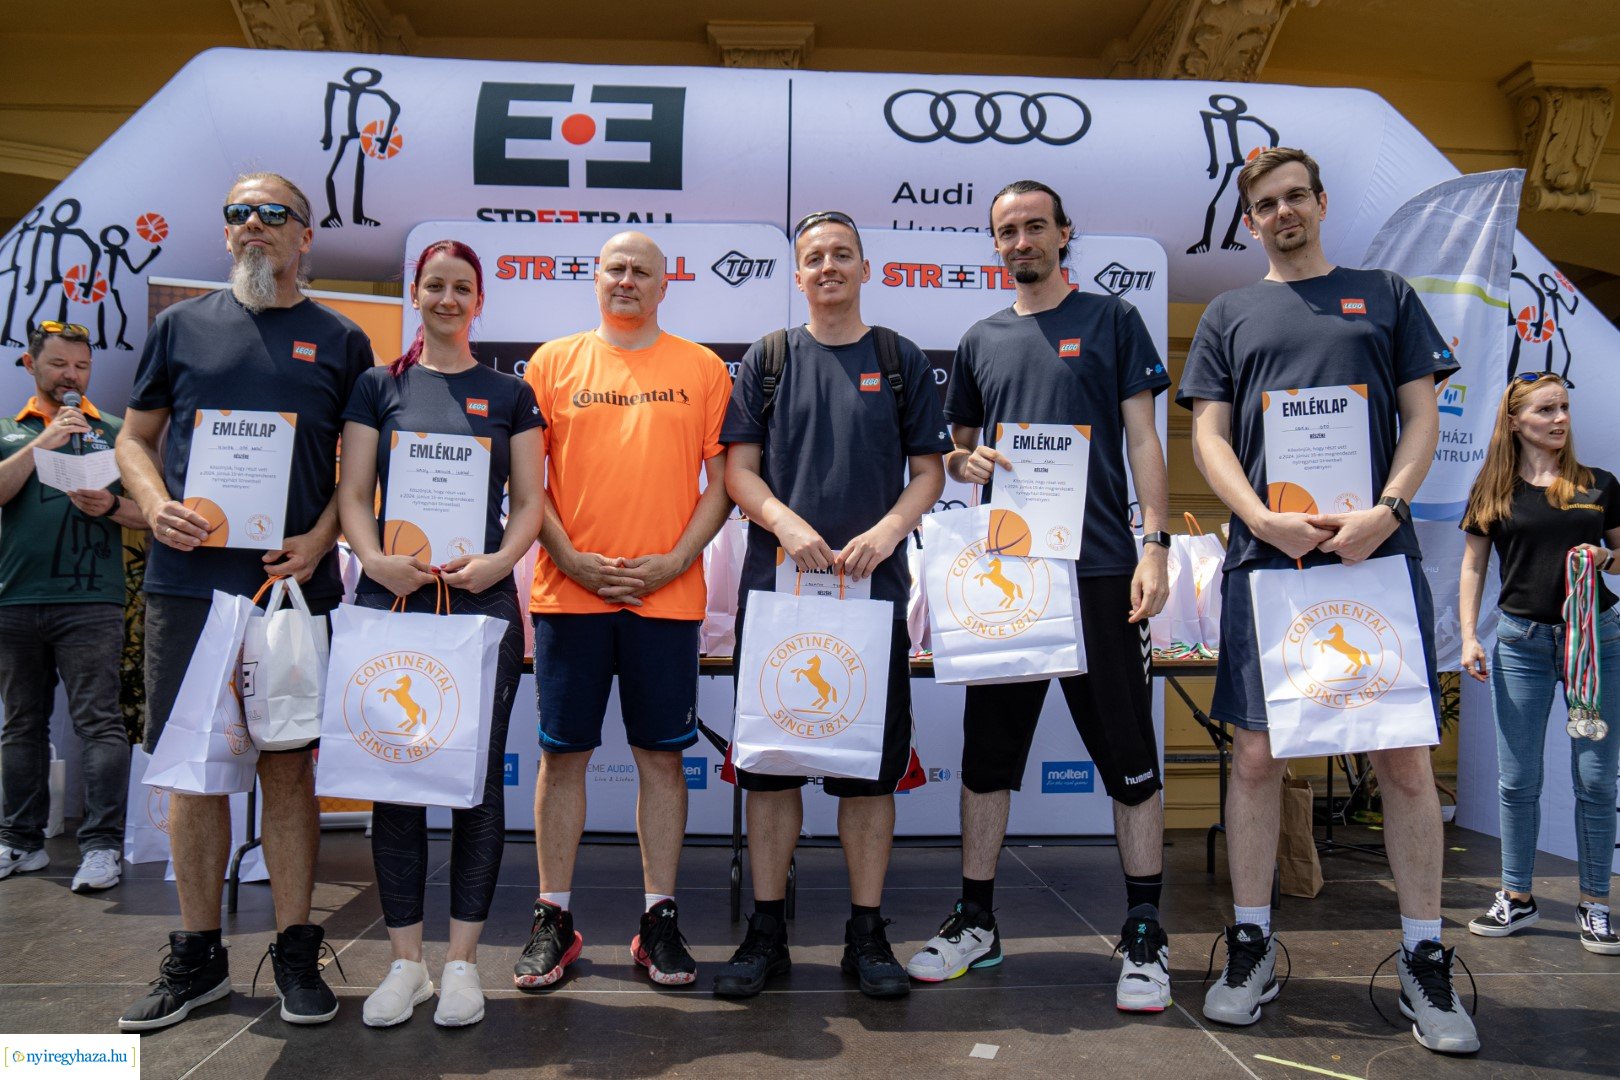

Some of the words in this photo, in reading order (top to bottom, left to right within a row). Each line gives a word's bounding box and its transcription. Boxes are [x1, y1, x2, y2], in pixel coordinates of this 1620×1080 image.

[892, 182, 973, 205] Audi
[726, 258, 776, 278] TOTI
[1109, 270, 1155, 291] TOTI
[1343, 302, 1363, 310] LEGO
[295, 346, 314, 356] LEGO
[1060, 343, 1079, 352] LEGO
[861, 377, 879, 387] LEGO
[468, 402, 487, 411] LEGO
[572, 387, 674, 408] Continental
[1282, 397, 1348, 417] EMLÉKLAP
[212, 420, 277, 438] EMLÉKLAP
[1439, 429, 1473, 444] HÁZI
[409, 442, 472, 462] EMLÉKLAP
[1013, 433, 1072, 451] EMLÉKLAP
[964, 615, 1006, 636] SINCE
[1010, 608, 1039, 632] 1871
[1289, 603, 1387, 643] CONTINENTAL
[770, 636, 859, 675] CONTINENTAL
[355, 655, 453, 695] CONTINENTAL
[1305, 683, 1352, 705] SINCE
[1358, 677, 1389, 701] 1871
[774, 709, 815, 736] SINCE
[820, 714, 849, 734] 1871
[359, 730, 402, 760] SINCE
[406, 737, 438, 759] 1871
[606, 764, 634, 773] AUDIO
[1048, 768, 1088, 780] molten
[1124, 768, 1154, 785] hummel
